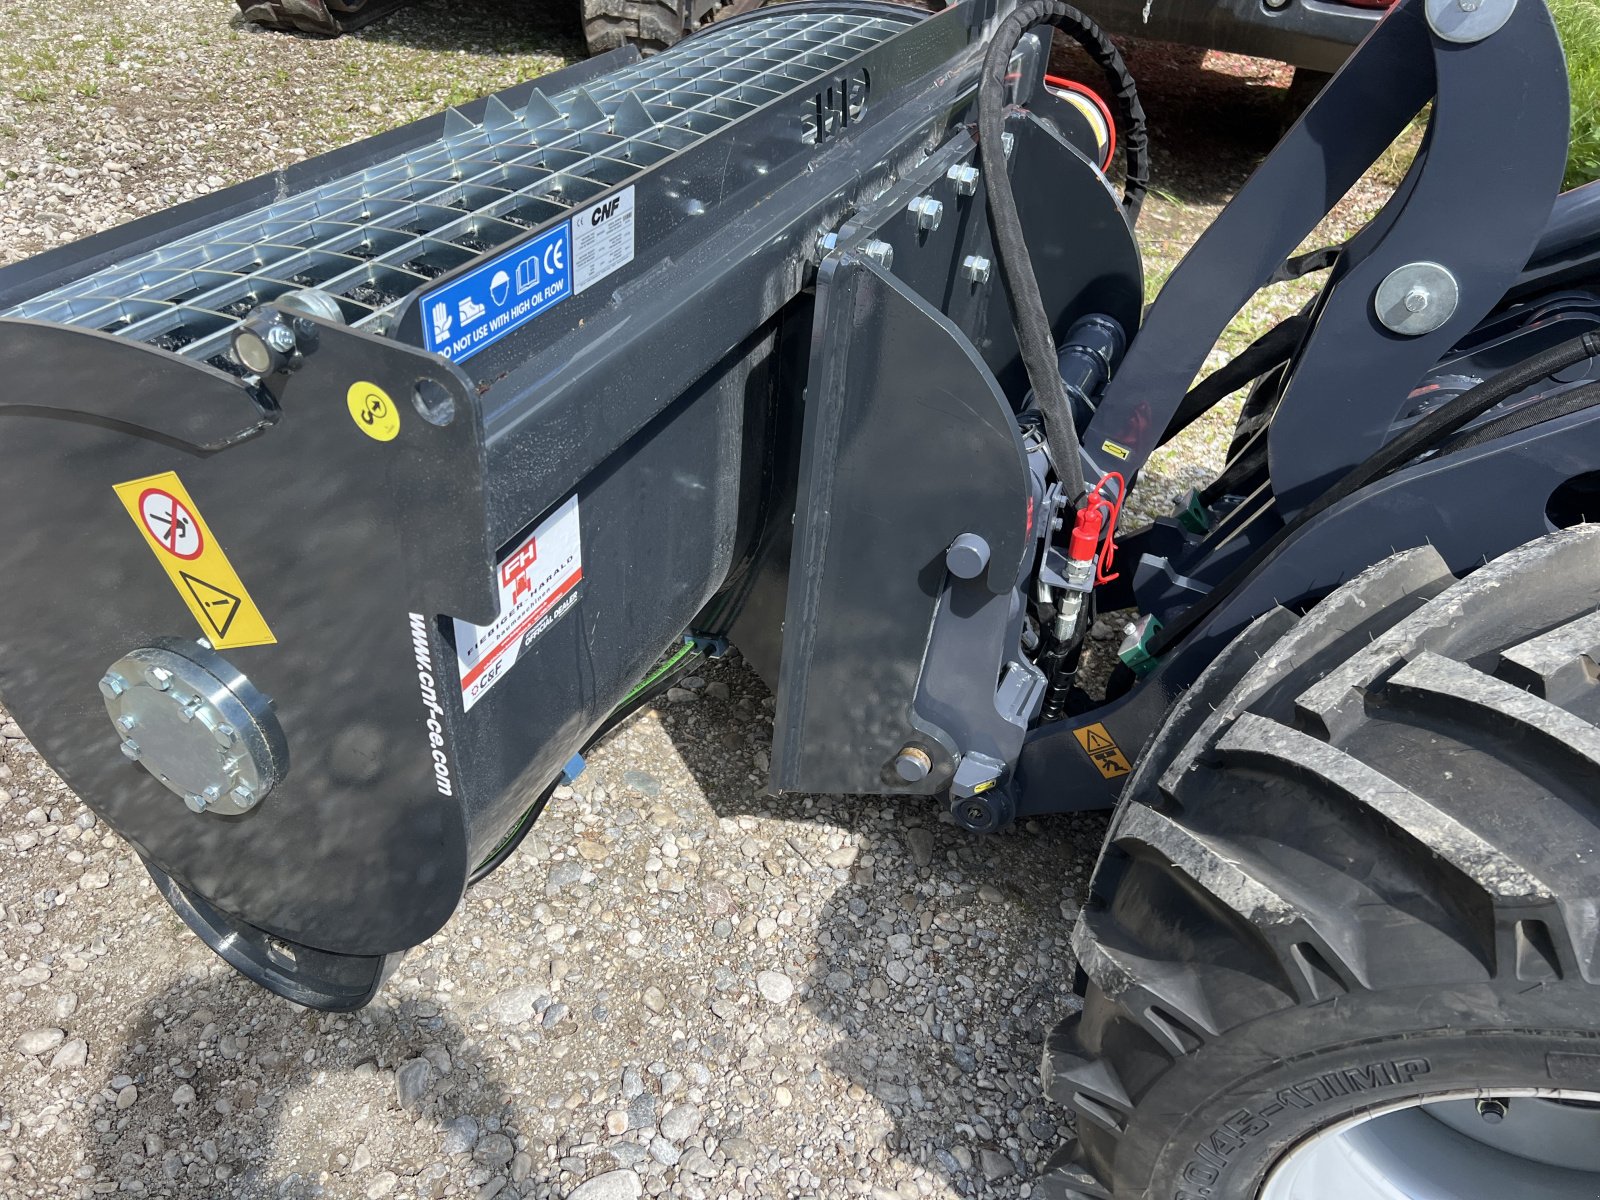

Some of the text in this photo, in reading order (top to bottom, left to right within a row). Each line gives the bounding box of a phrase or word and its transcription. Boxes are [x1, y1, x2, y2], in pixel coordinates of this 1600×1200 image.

[591, 196, 621, 227] CNF
[543, 238, 564, 275] CE
[453, 334, 472, 355] NOT
[473, 327, 489, 342] USE
[489, 312, 510, 332] WITH
[511, 301, 531, 320] HIGH
[531, 292, 544, 306] OIL
[544, 278, 564, 299] FLOW
[504, 543, 534, 581] FH
[525, 615, 554, 646] OFFICIAL
[553, 590, 578, 619] DEALER
[480, 659, 503, 689] C&F
[408, 612, 453, 797] www.cnf-ce.com
